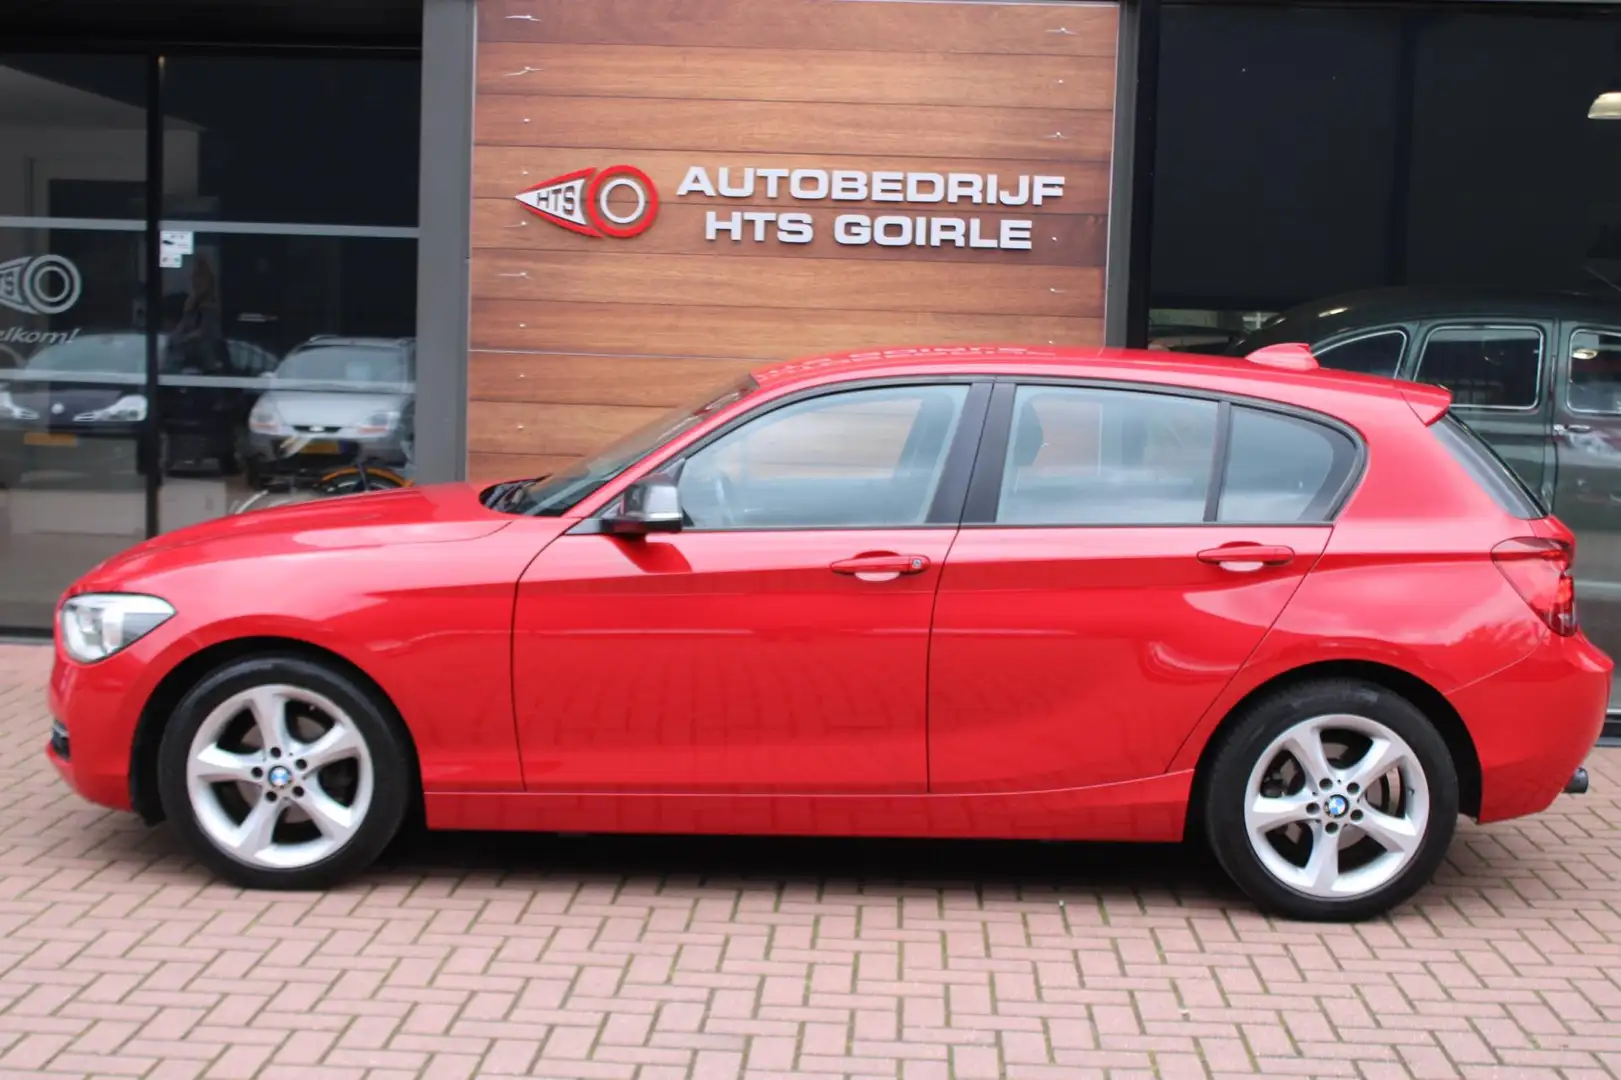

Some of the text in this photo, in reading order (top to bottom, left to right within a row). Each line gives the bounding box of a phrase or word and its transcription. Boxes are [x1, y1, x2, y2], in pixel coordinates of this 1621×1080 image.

[537, 185, 576, 216] HTS
[676, 166, 1066, 206] AUTOBEDRIJF
[705, 211, 1033, 250] HTS GOIRLE
